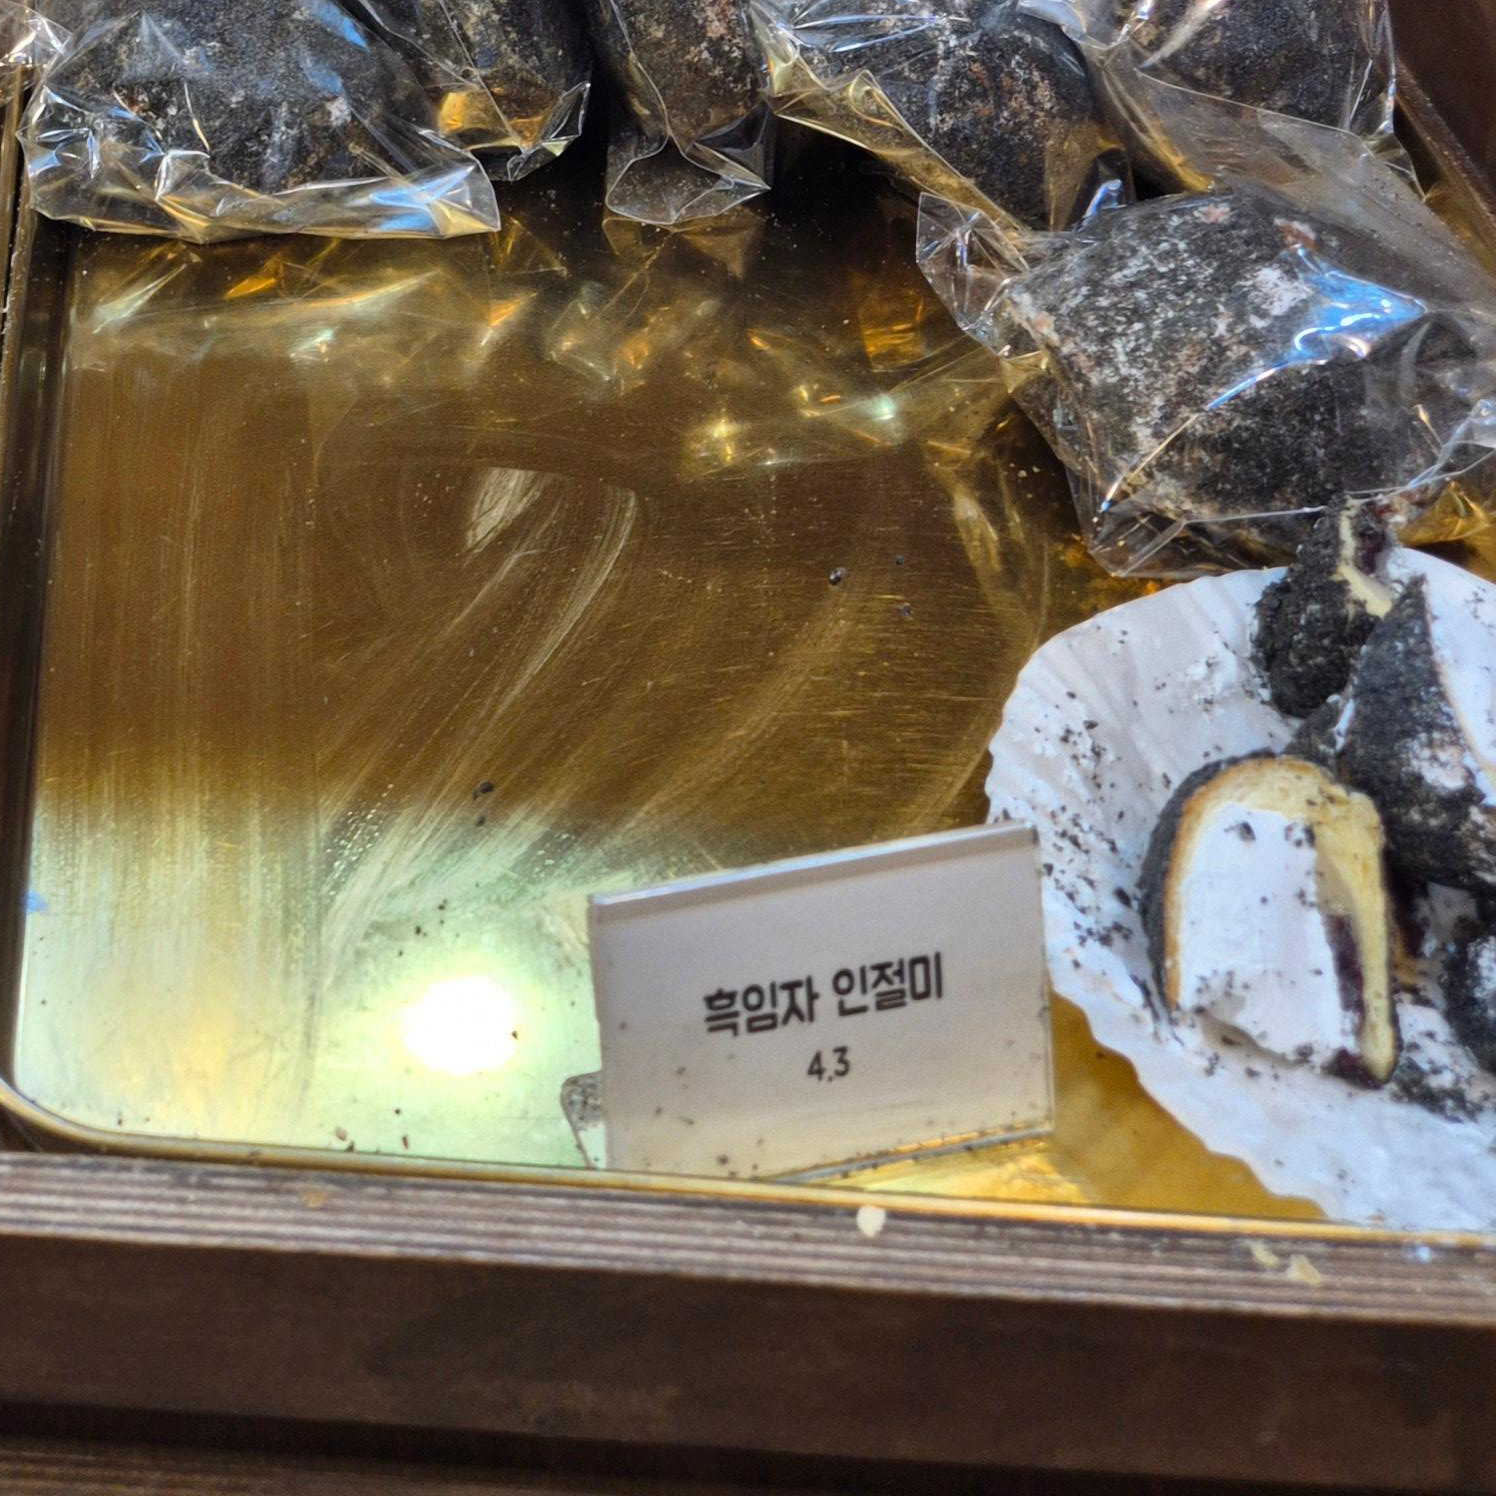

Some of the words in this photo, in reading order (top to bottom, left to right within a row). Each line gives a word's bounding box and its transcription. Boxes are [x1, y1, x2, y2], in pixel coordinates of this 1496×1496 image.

[702, 975, 820, 1037] 흑임자
[831, 951, 944, 1017] 인절미
[807, 1045, 851, 1082] 4.3
